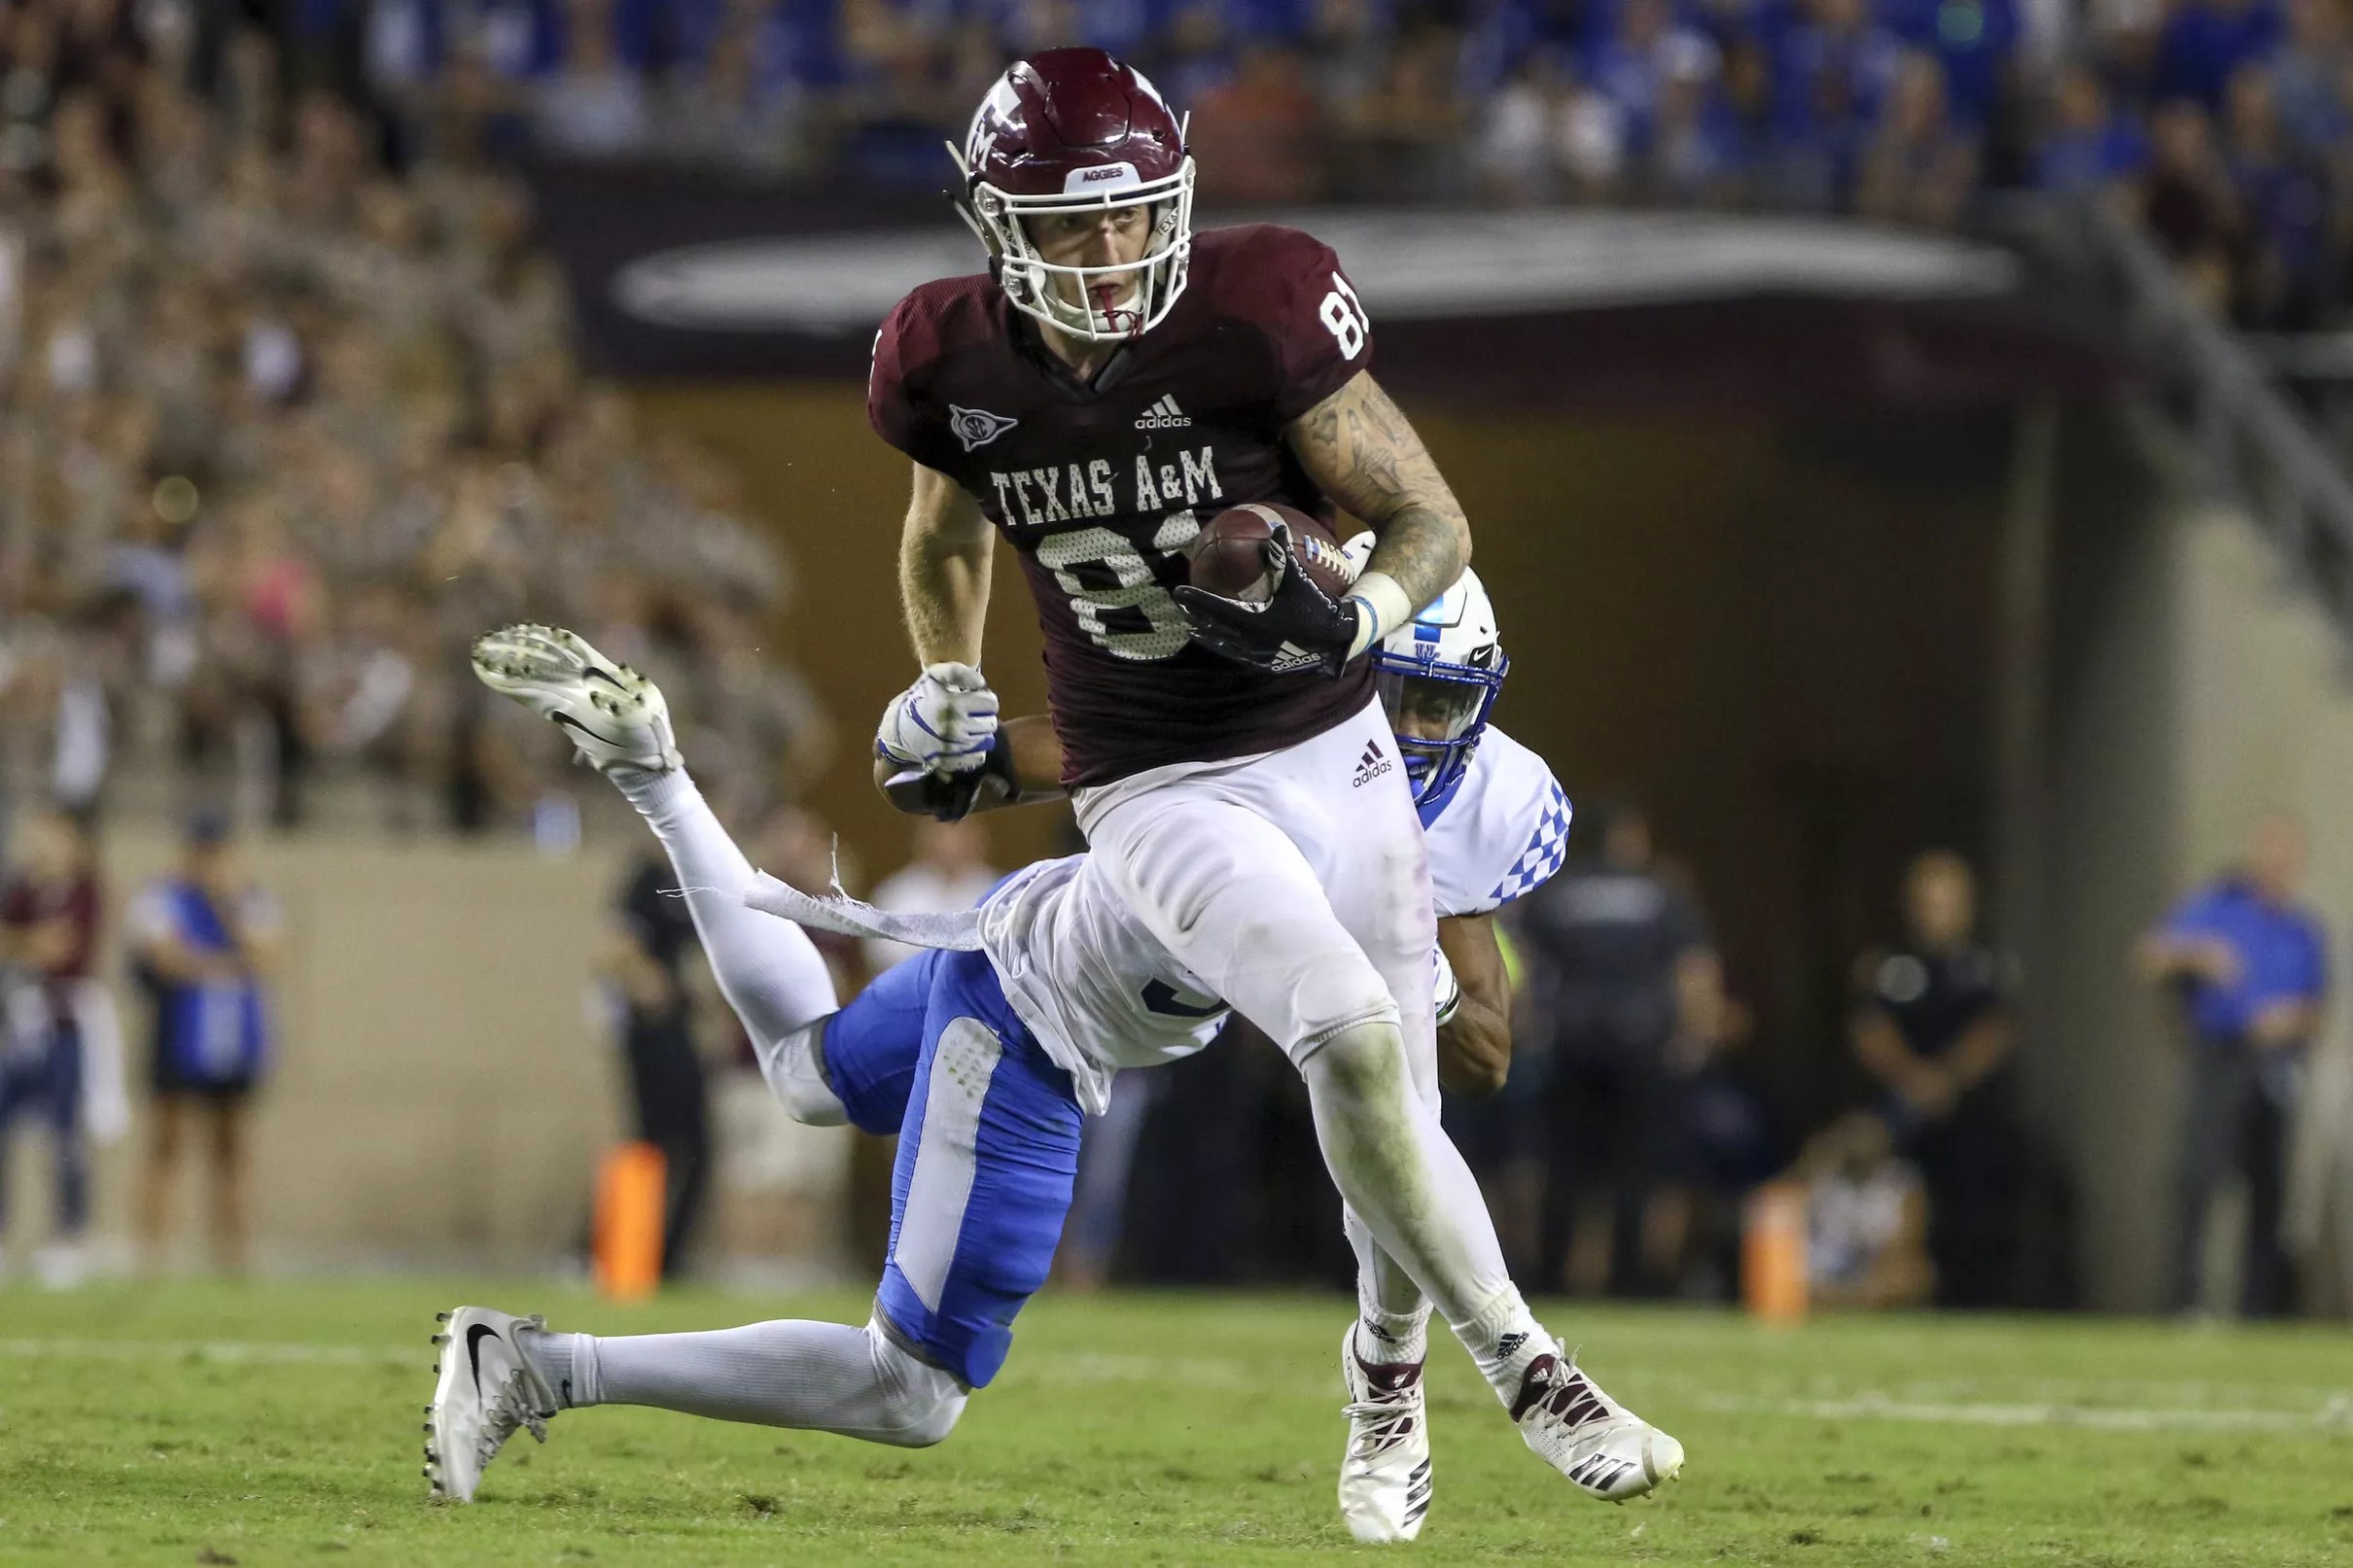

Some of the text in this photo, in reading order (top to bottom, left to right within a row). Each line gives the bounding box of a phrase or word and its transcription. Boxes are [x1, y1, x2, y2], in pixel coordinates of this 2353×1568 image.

[1081, 166, 1124, 183] AGGIES
[1319, 270, 1370, 361] 81
[1135, 415, 1192, 430] adidas
[990, 445, 1223, 526] TEXAS A&M
[1271, 652, 1321, 672] adidas
[1352, 759, 1392, 788] adidas
[1497, 1331, 1530, 1361] adidas
